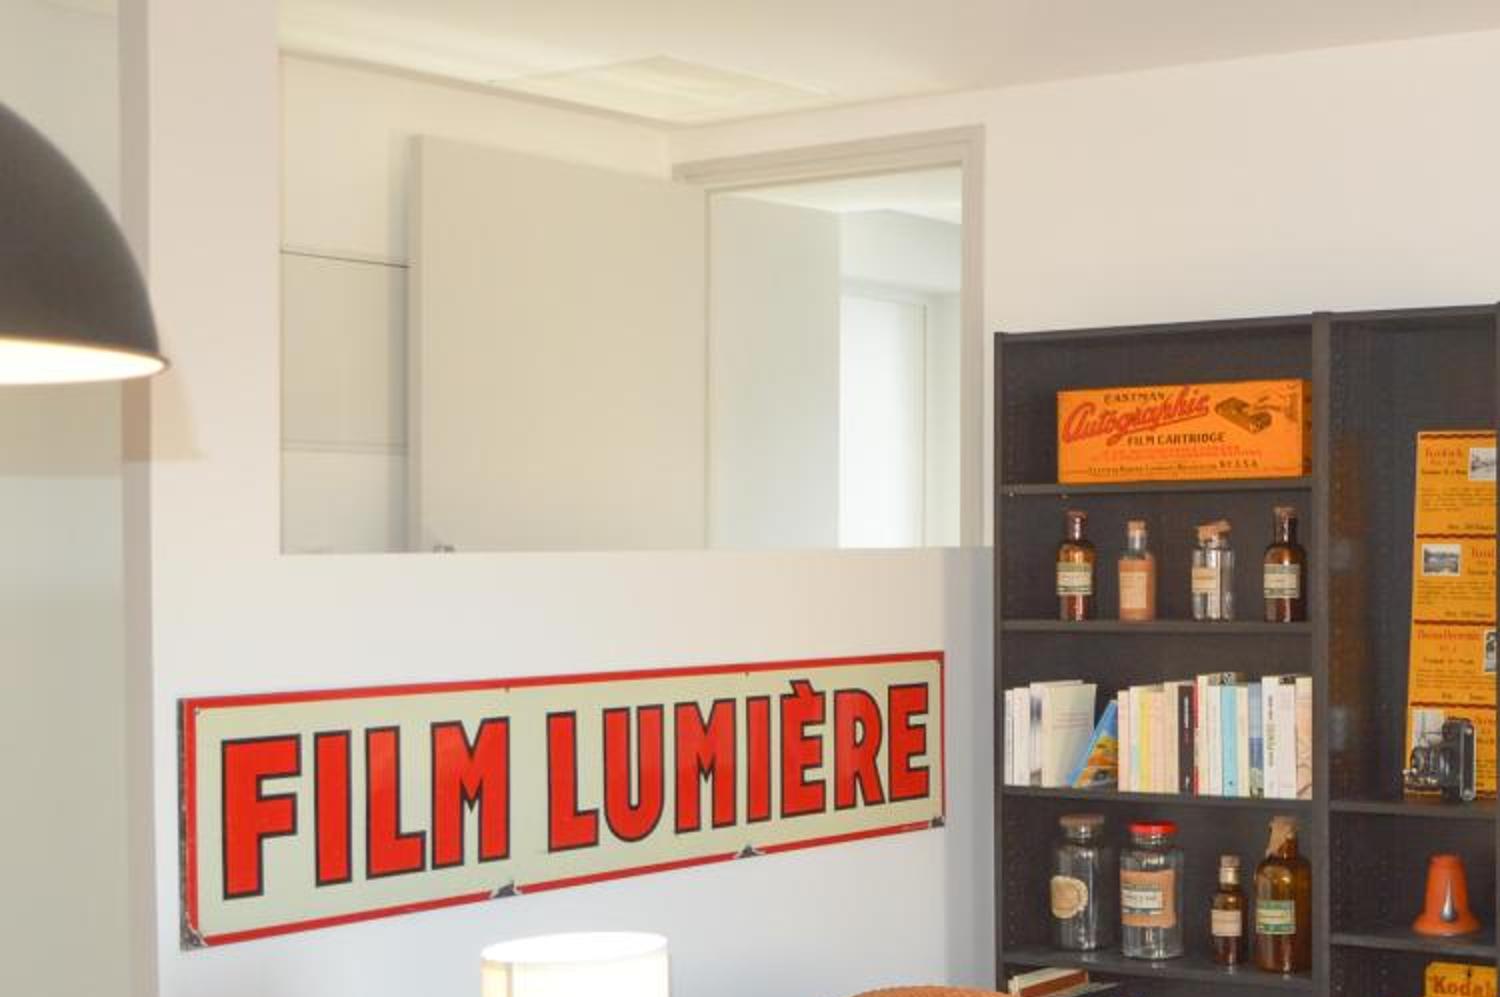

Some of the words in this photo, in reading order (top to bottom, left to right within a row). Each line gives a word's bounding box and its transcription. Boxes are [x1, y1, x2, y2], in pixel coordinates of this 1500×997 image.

[1061, 385, 1212, 447] Autographic
[1127, 434, 1155, 447] FILM
[1157, 431, 1227, 446] CARTRIDGE
[221, 716, 511, 900] FILM
[546, 680, 931, 854] LUMIÈRE
